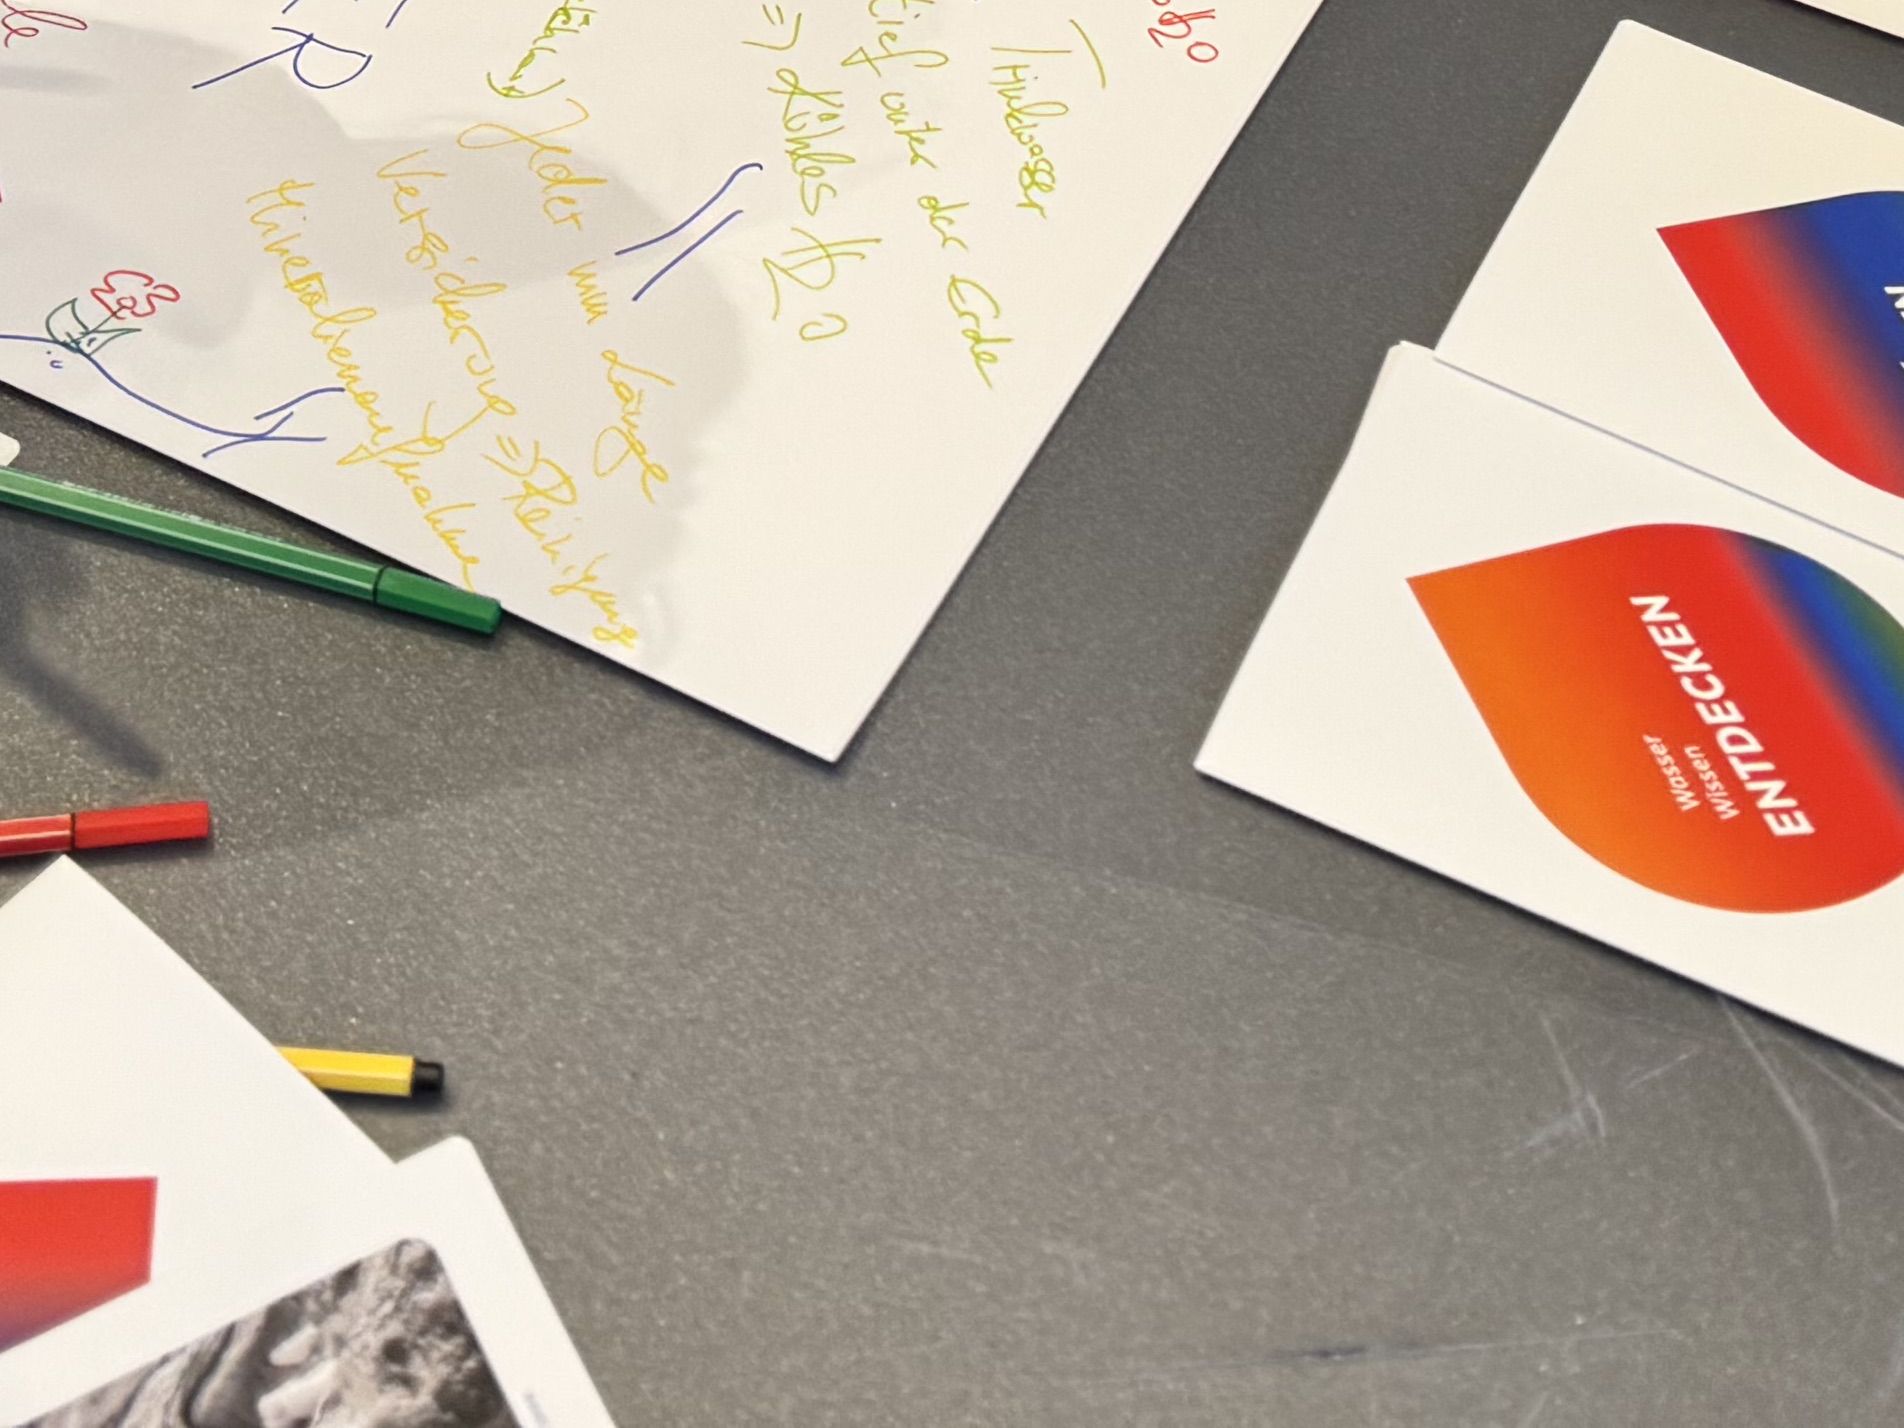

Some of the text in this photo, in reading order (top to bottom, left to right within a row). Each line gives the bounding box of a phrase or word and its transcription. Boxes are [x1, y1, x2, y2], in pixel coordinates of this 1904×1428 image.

[918, 196, 968, 249] der
[1630, 595, 1814, 837] ENTDECKEN
[1643, 733, 1700, 812] Wasser
[1684, 744, 1740, 820] Wissen
